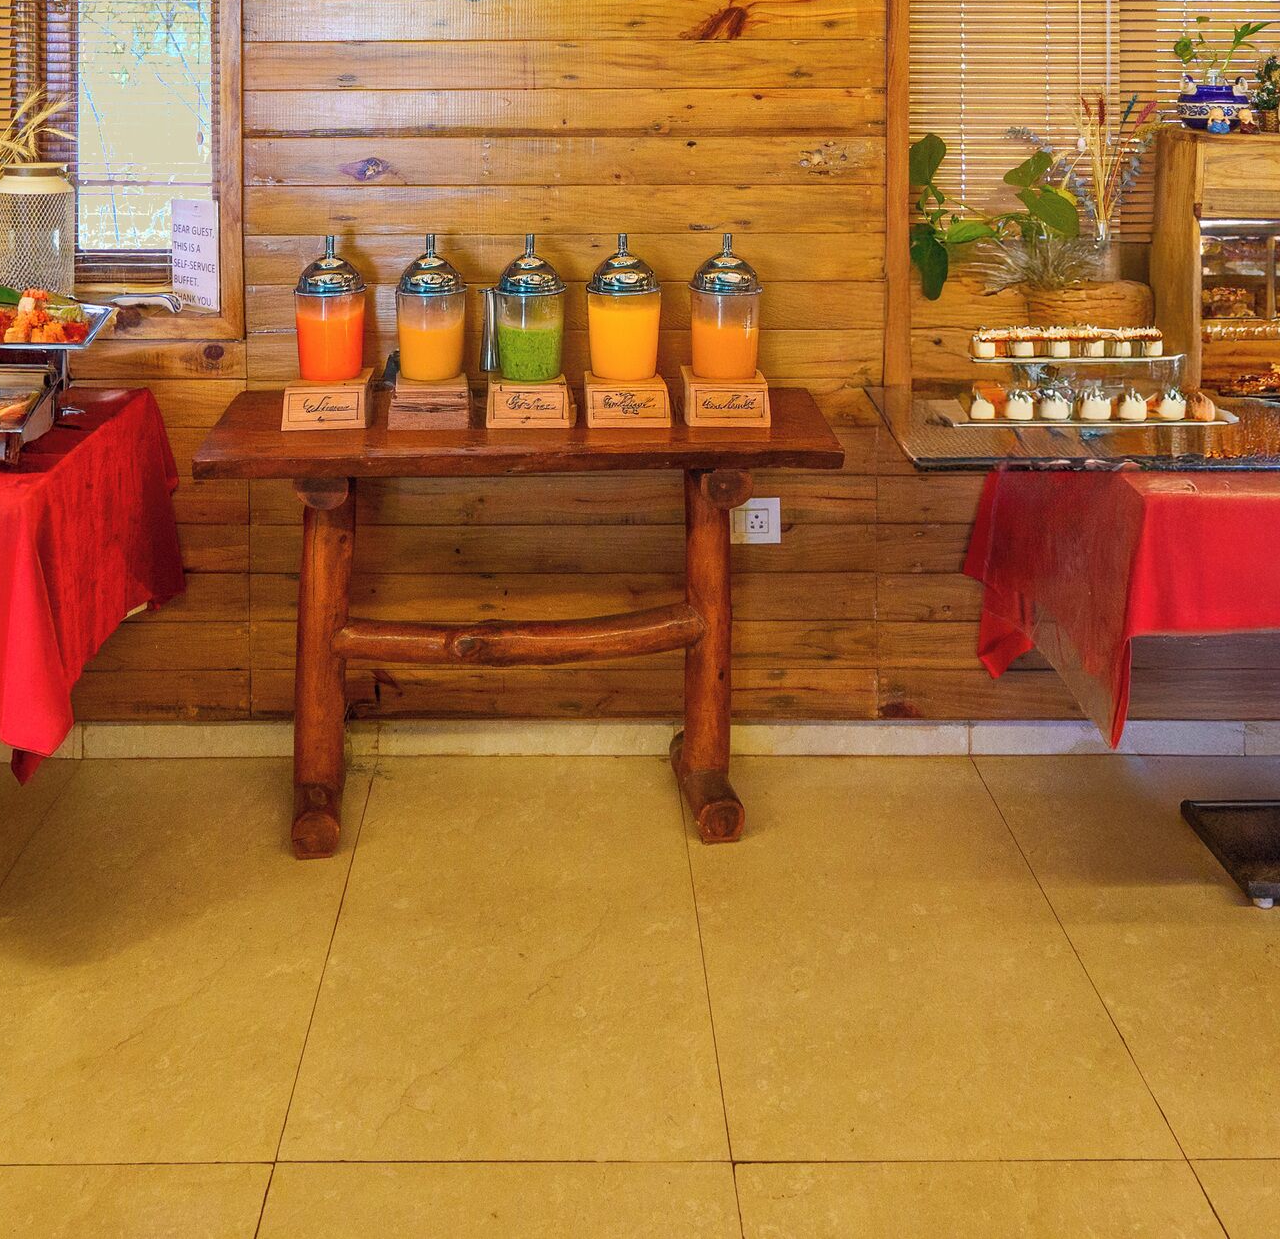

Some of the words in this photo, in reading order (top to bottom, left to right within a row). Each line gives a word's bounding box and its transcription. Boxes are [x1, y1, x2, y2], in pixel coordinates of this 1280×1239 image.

[173, 223, 190, 234] DEAR
[191, 226, 215, 239] GUEST,
[173, 241, 187, 252] THIS
[188, 243, 195, 252] IS
[196, 244, 201, 253] A
[173, 258, 216, 274] SELF-SERVICE
[173, 274, 200, 287] BUFFET.
[197, 296, 214, 307] YOU.
